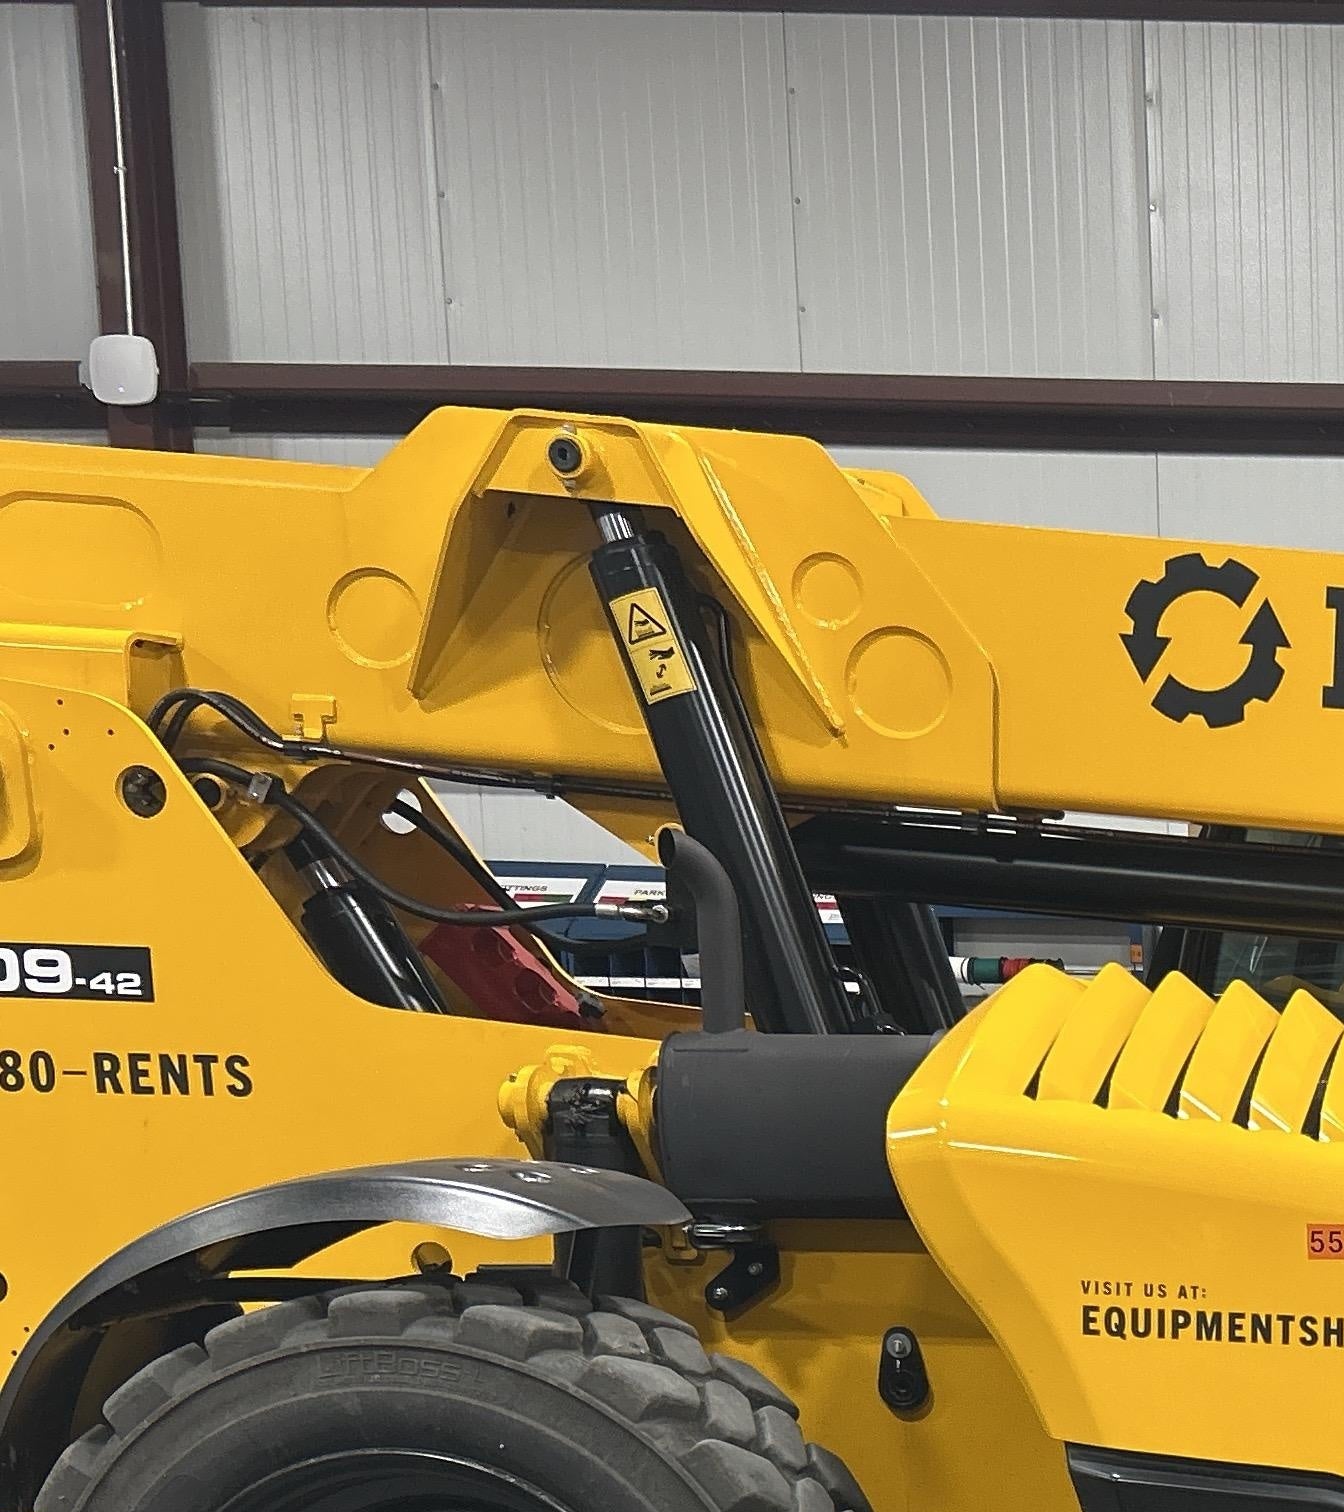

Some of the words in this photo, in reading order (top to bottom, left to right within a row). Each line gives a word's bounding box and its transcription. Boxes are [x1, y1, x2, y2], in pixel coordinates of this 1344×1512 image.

[1081, 1280, 1133, 1297] VISIT
[1144, 1283, 1168, 1299] US
[1177, 1285, 1208, 1300] AT:
